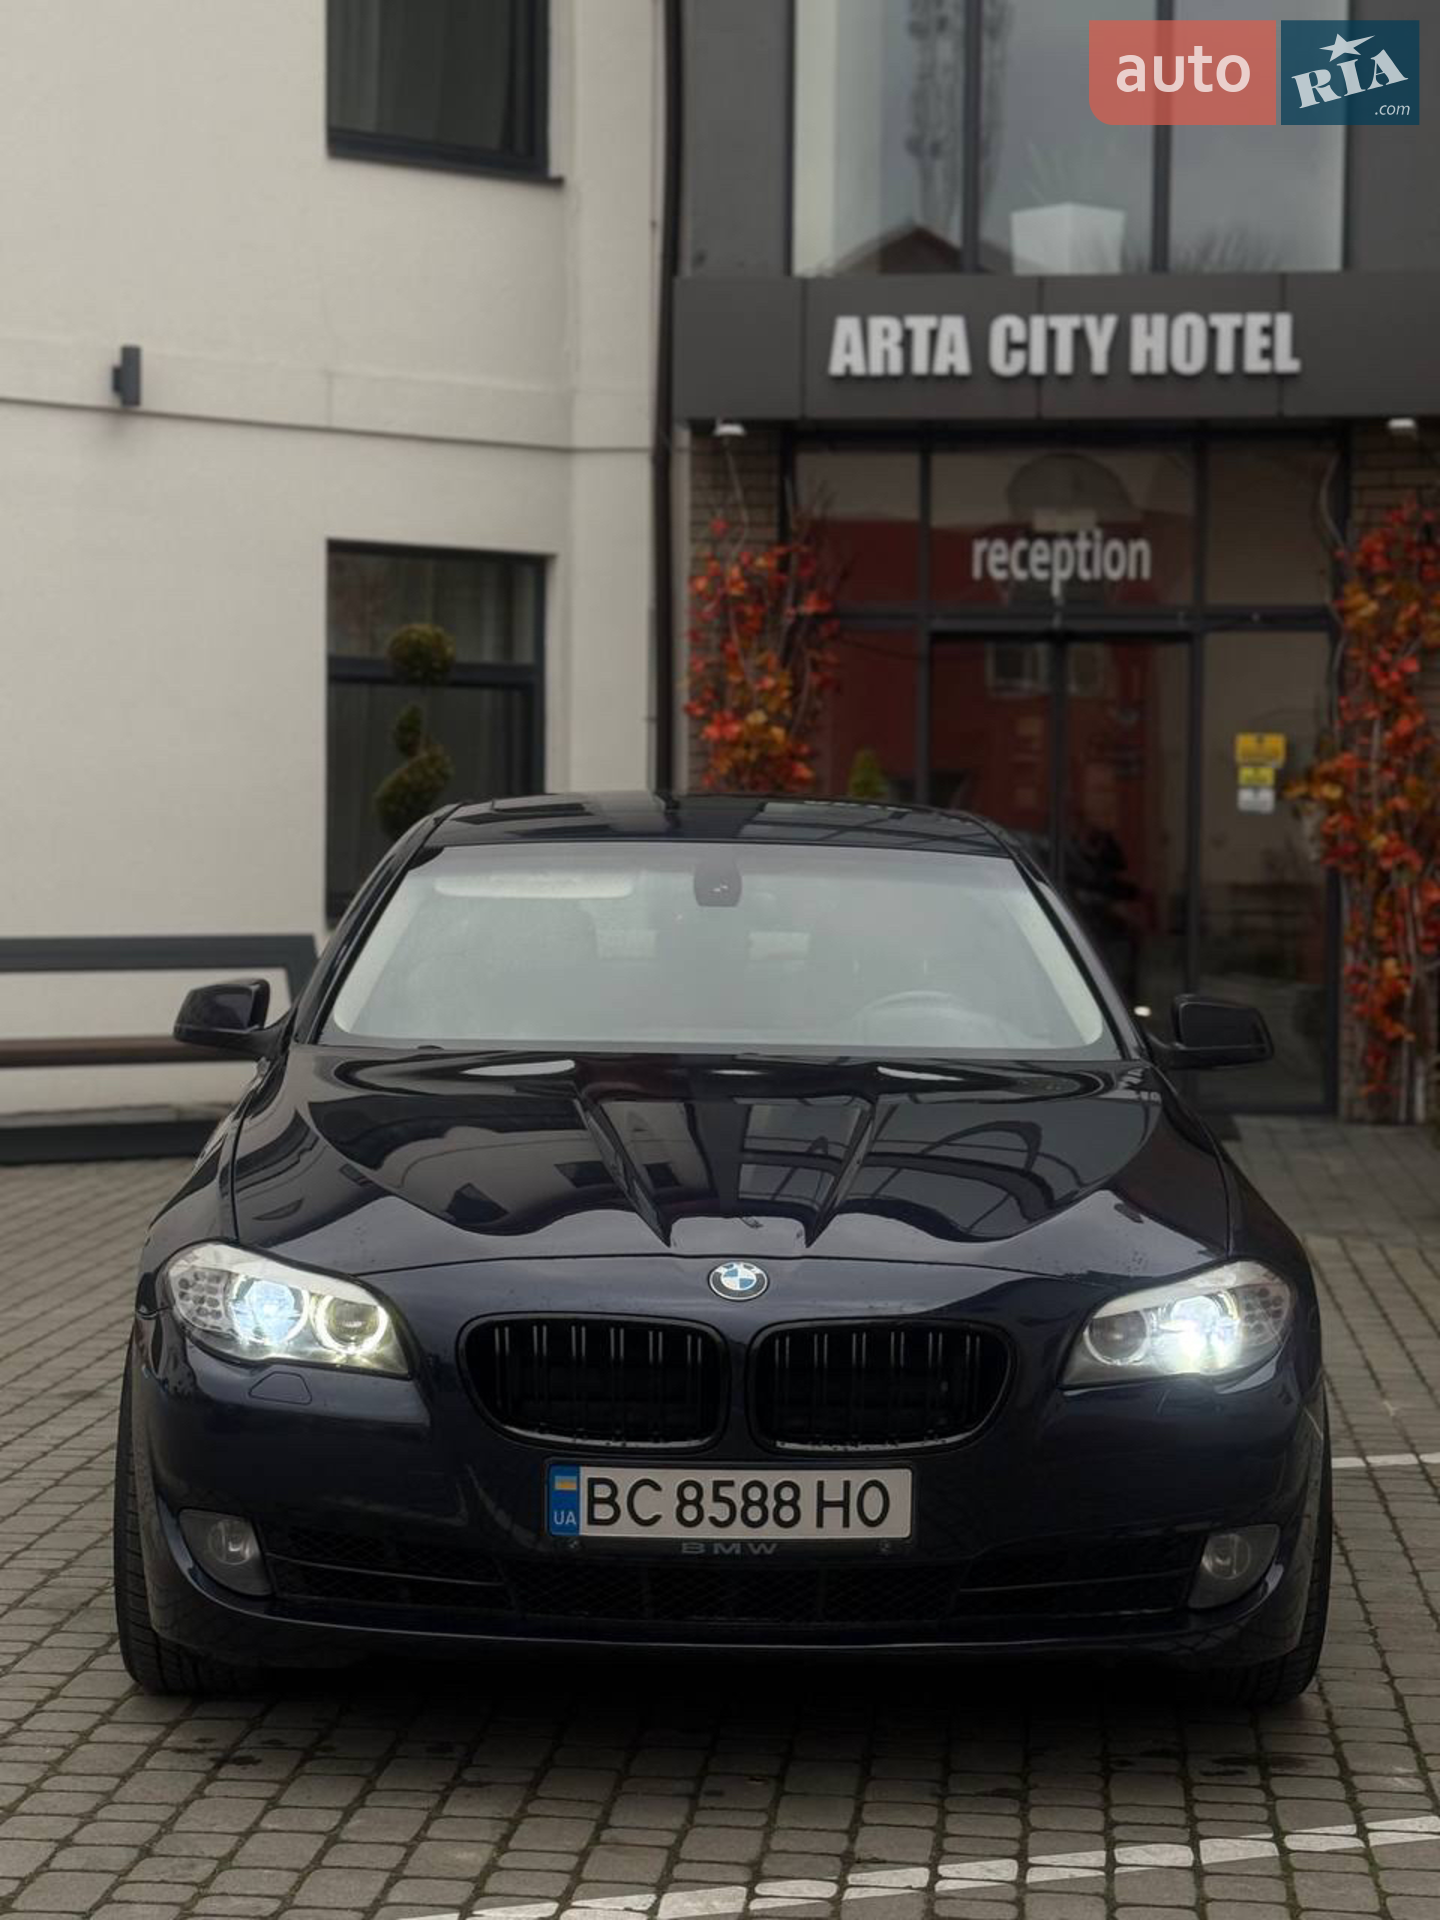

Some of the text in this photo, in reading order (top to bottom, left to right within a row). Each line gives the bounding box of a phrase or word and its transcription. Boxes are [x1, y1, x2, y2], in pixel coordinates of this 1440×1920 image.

[828, 312, 1301, 376] ARTA CITY HOTEL
[971, 530, 1152, 599] reception
[553, 1510, 577, 1526] UA
[585, 1476, 663, 1528] BC
[674, 1478, 802, 1529] 8588
[681, 1542, 778, 1556] BMW
